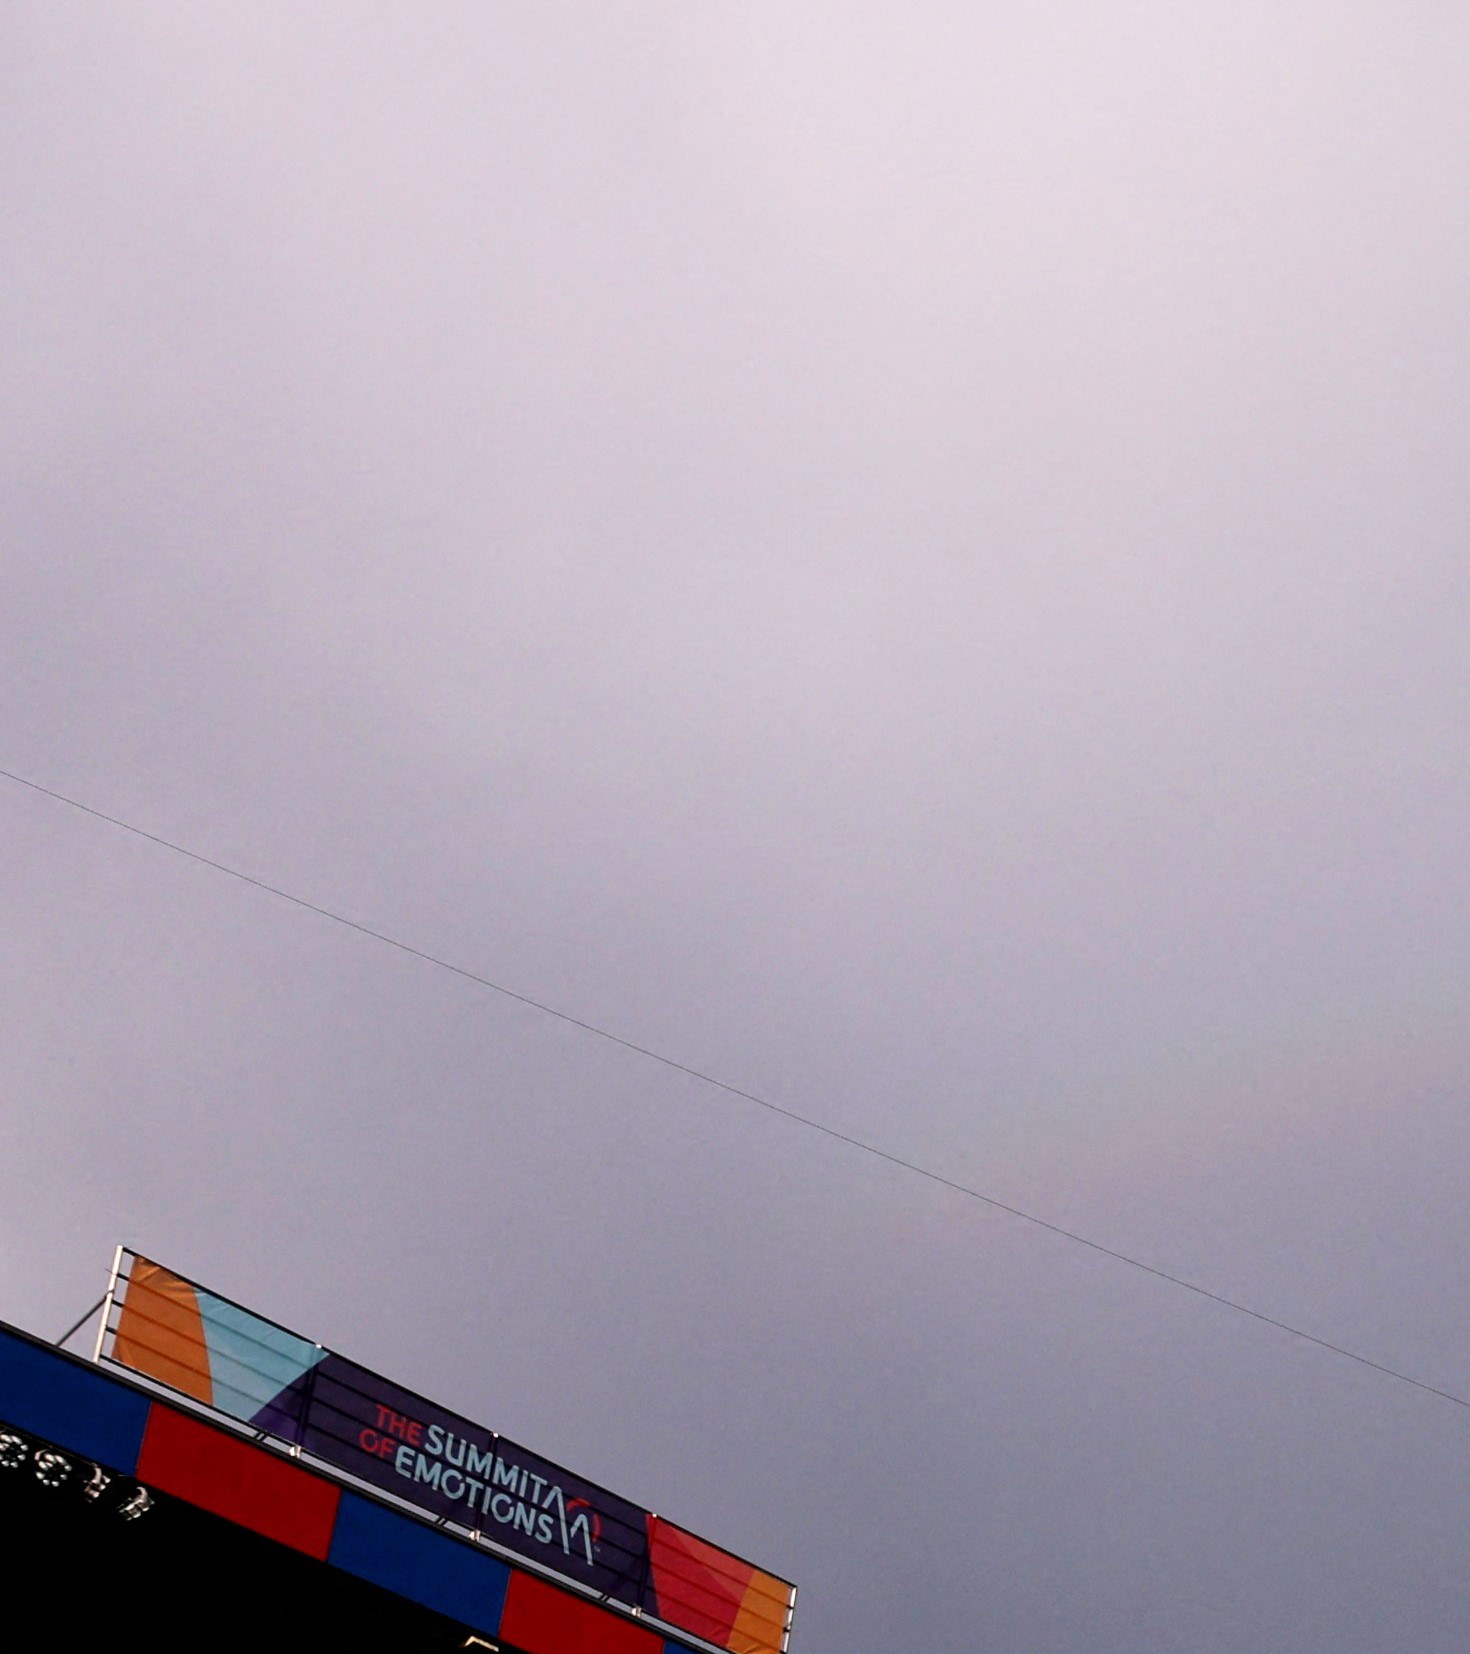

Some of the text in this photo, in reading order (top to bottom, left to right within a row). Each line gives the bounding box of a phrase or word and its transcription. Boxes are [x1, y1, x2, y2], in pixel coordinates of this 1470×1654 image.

[358, 1428, 554, 1544] OF EMOTIONS
[375, 1403, 548, 1505] THE SUMMIT
